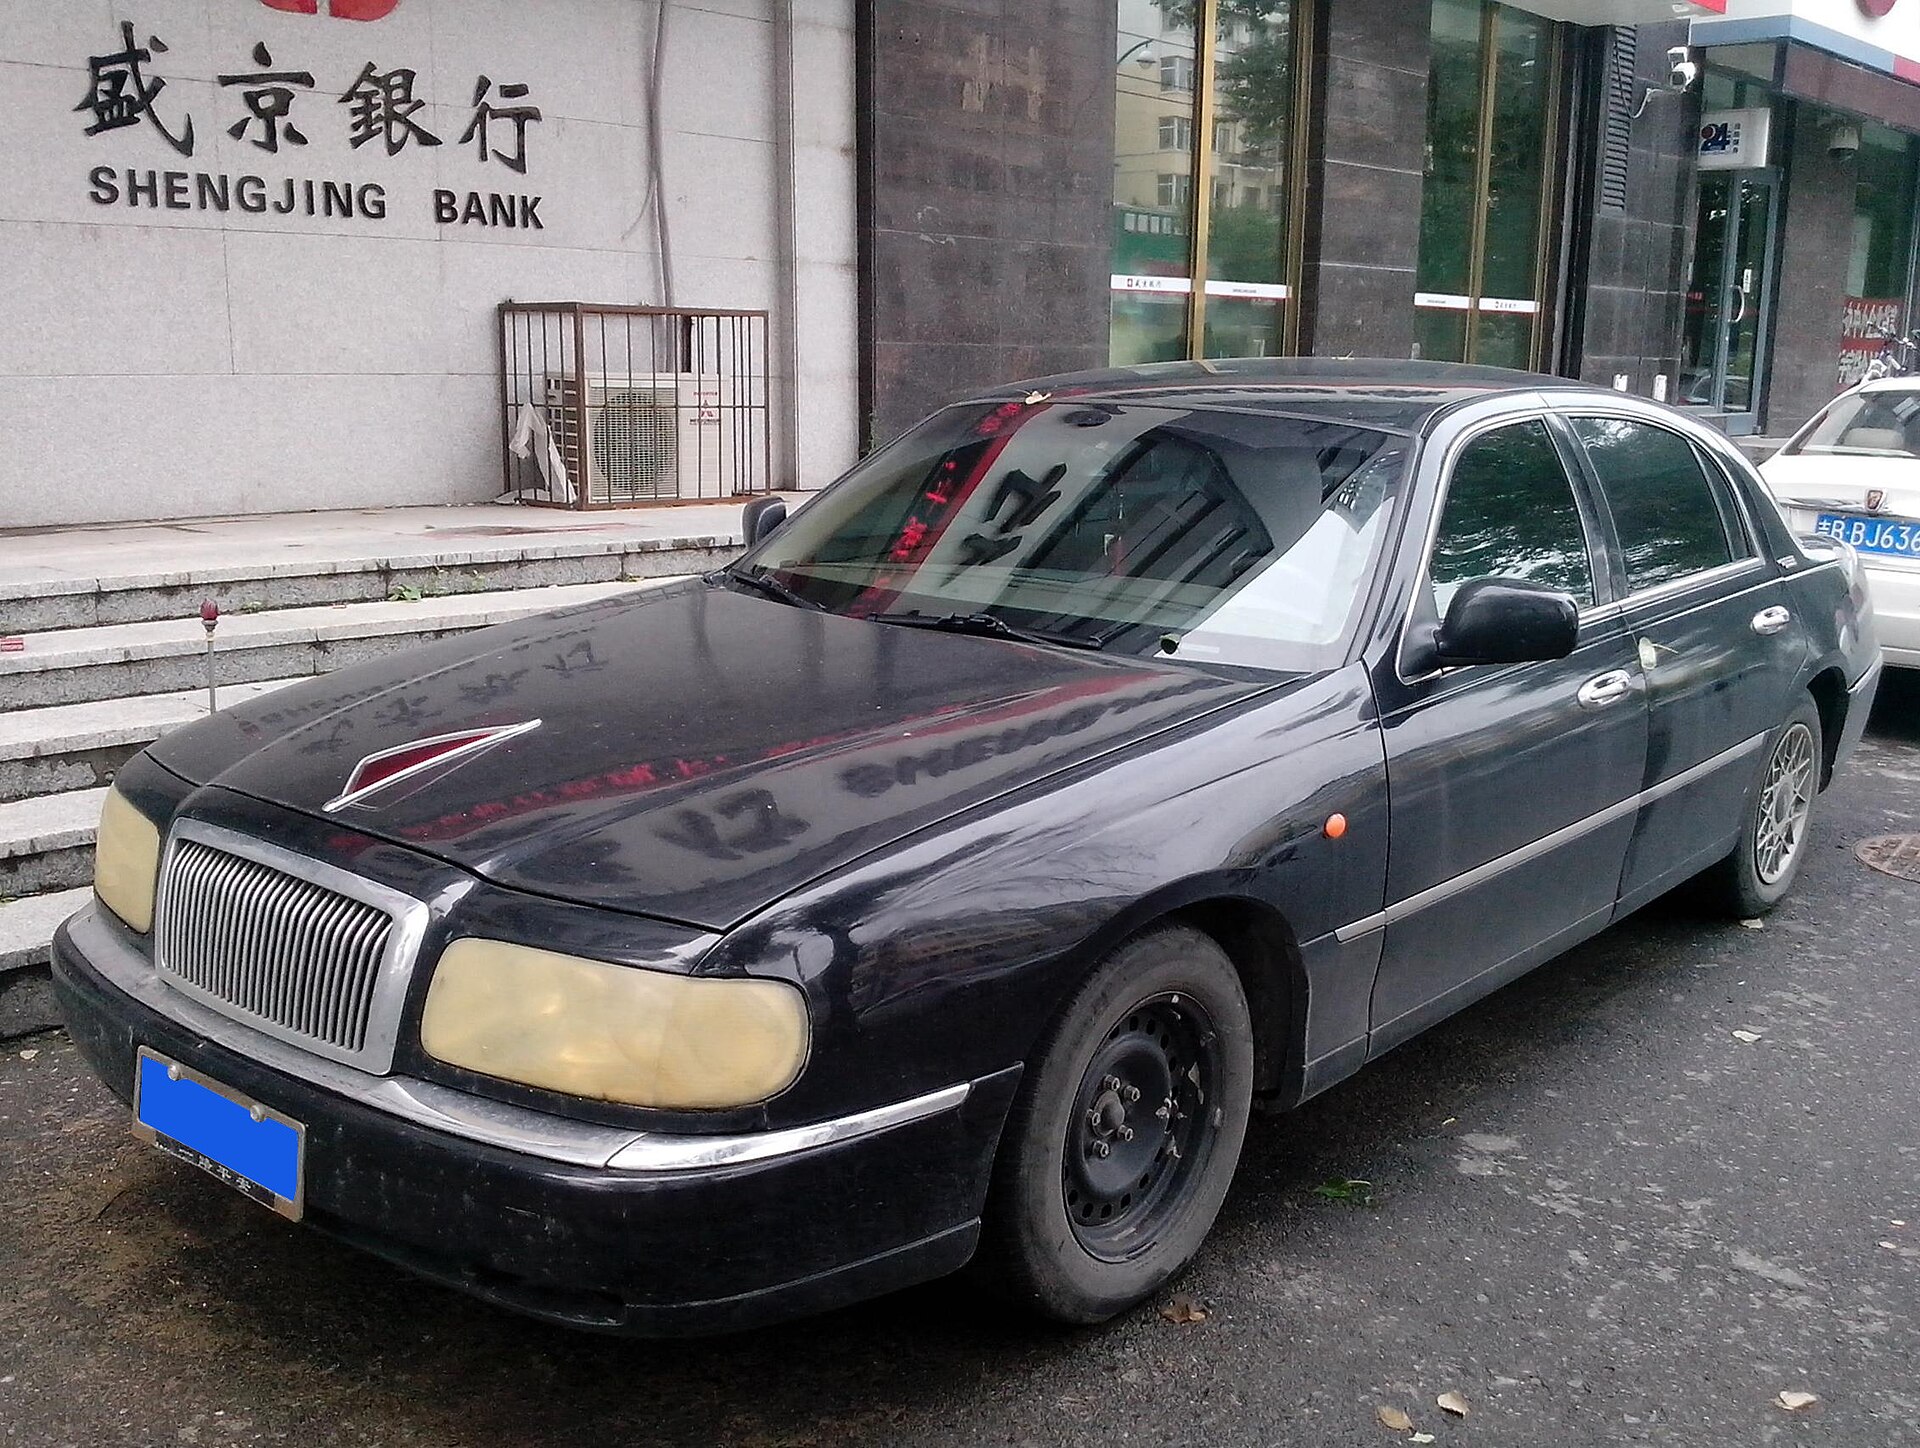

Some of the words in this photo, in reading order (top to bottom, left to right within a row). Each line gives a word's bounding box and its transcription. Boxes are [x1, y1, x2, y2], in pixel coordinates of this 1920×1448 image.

[72, 20, 543, 175] 盛京銀行
[89, 165, 386, 219] SHENGJING
[433, 189, 543, 229] BANK
